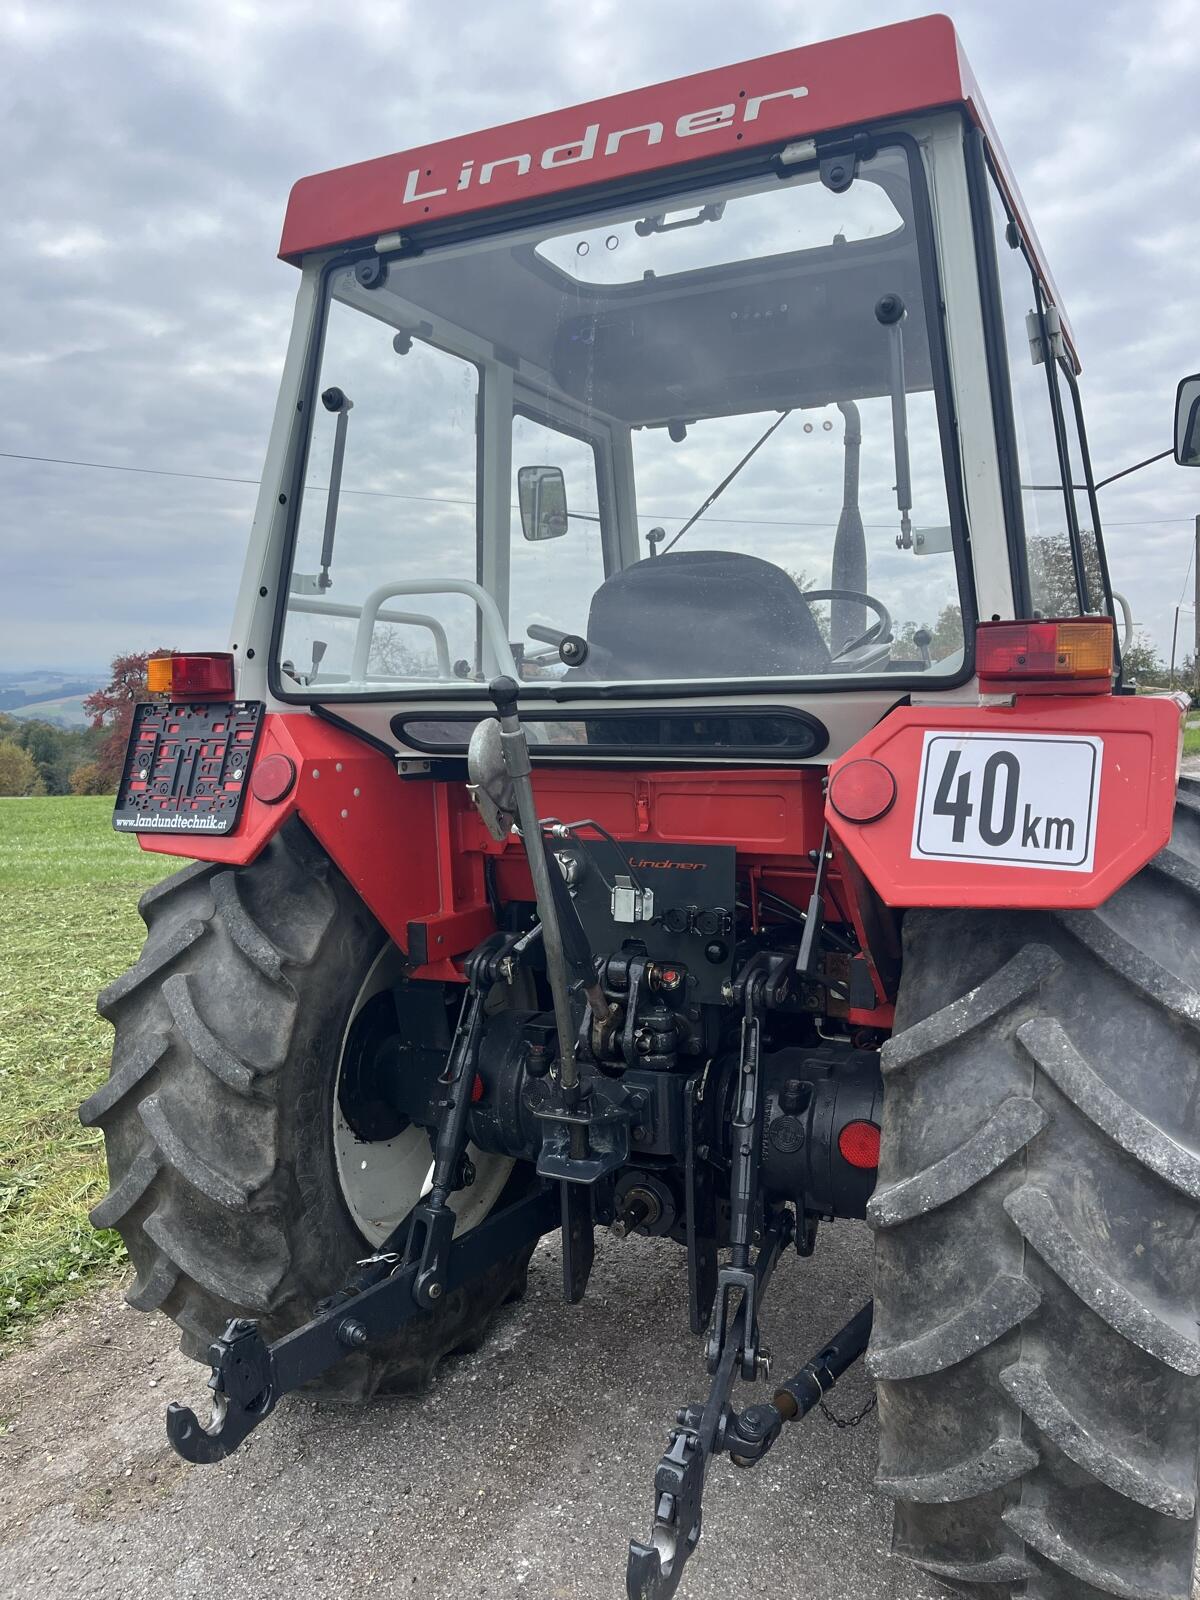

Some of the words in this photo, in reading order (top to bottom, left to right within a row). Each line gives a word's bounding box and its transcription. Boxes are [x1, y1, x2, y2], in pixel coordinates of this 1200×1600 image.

[402, 86, 809, 204] Lindner
[116, 813, 227, 829] www.landundtechnik.at
[932, 750, 1021, 847] 40
[1021, 803, 1075, 851] km
[628, 856, 708, 870] Lindner
